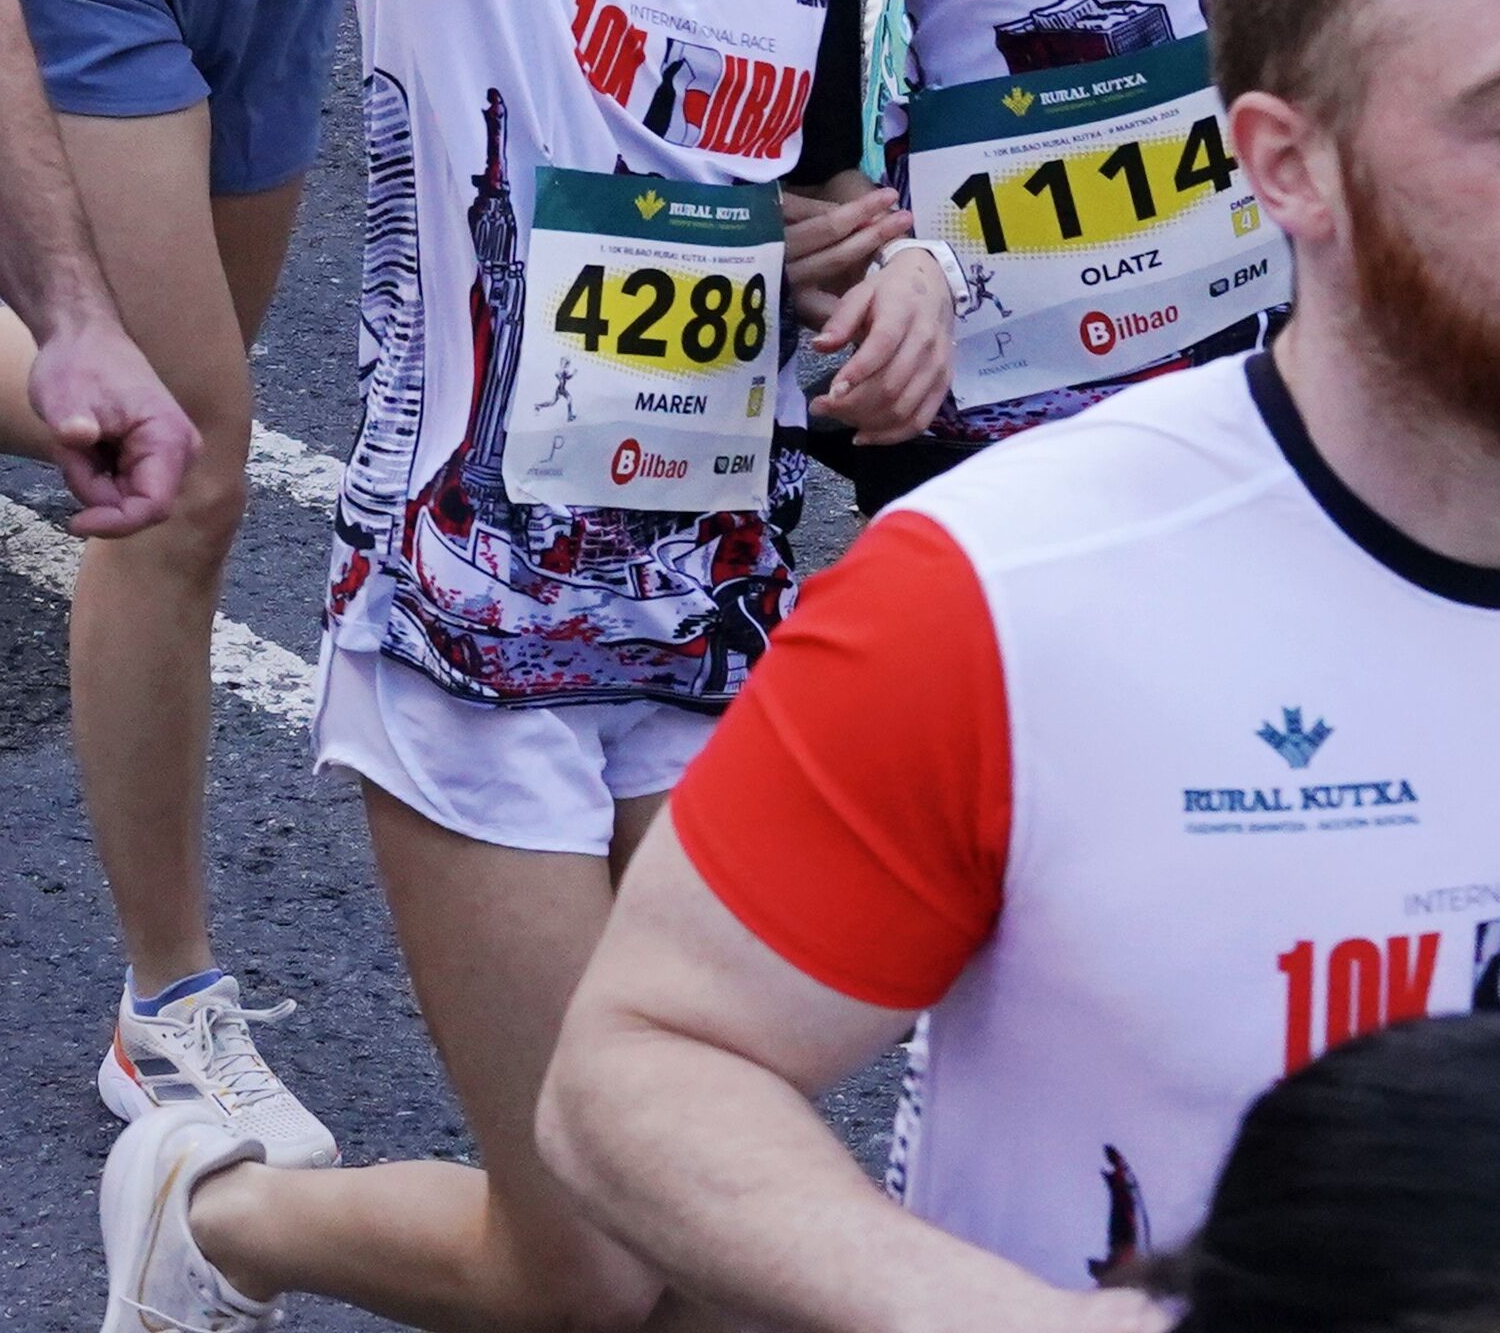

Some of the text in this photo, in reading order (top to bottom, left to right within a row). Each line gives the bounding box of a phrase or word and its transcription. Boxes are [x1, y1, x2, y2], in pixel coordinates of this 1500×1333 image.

[950, 113, 1238, 256] 1114
[1080, 249, 1163, 286] OLATZ
[555, 265, 769, 364] 4288
[634, 392, 708, 415] MAREN
[1183, 779, 1419, 813] RURAL KUTXA
